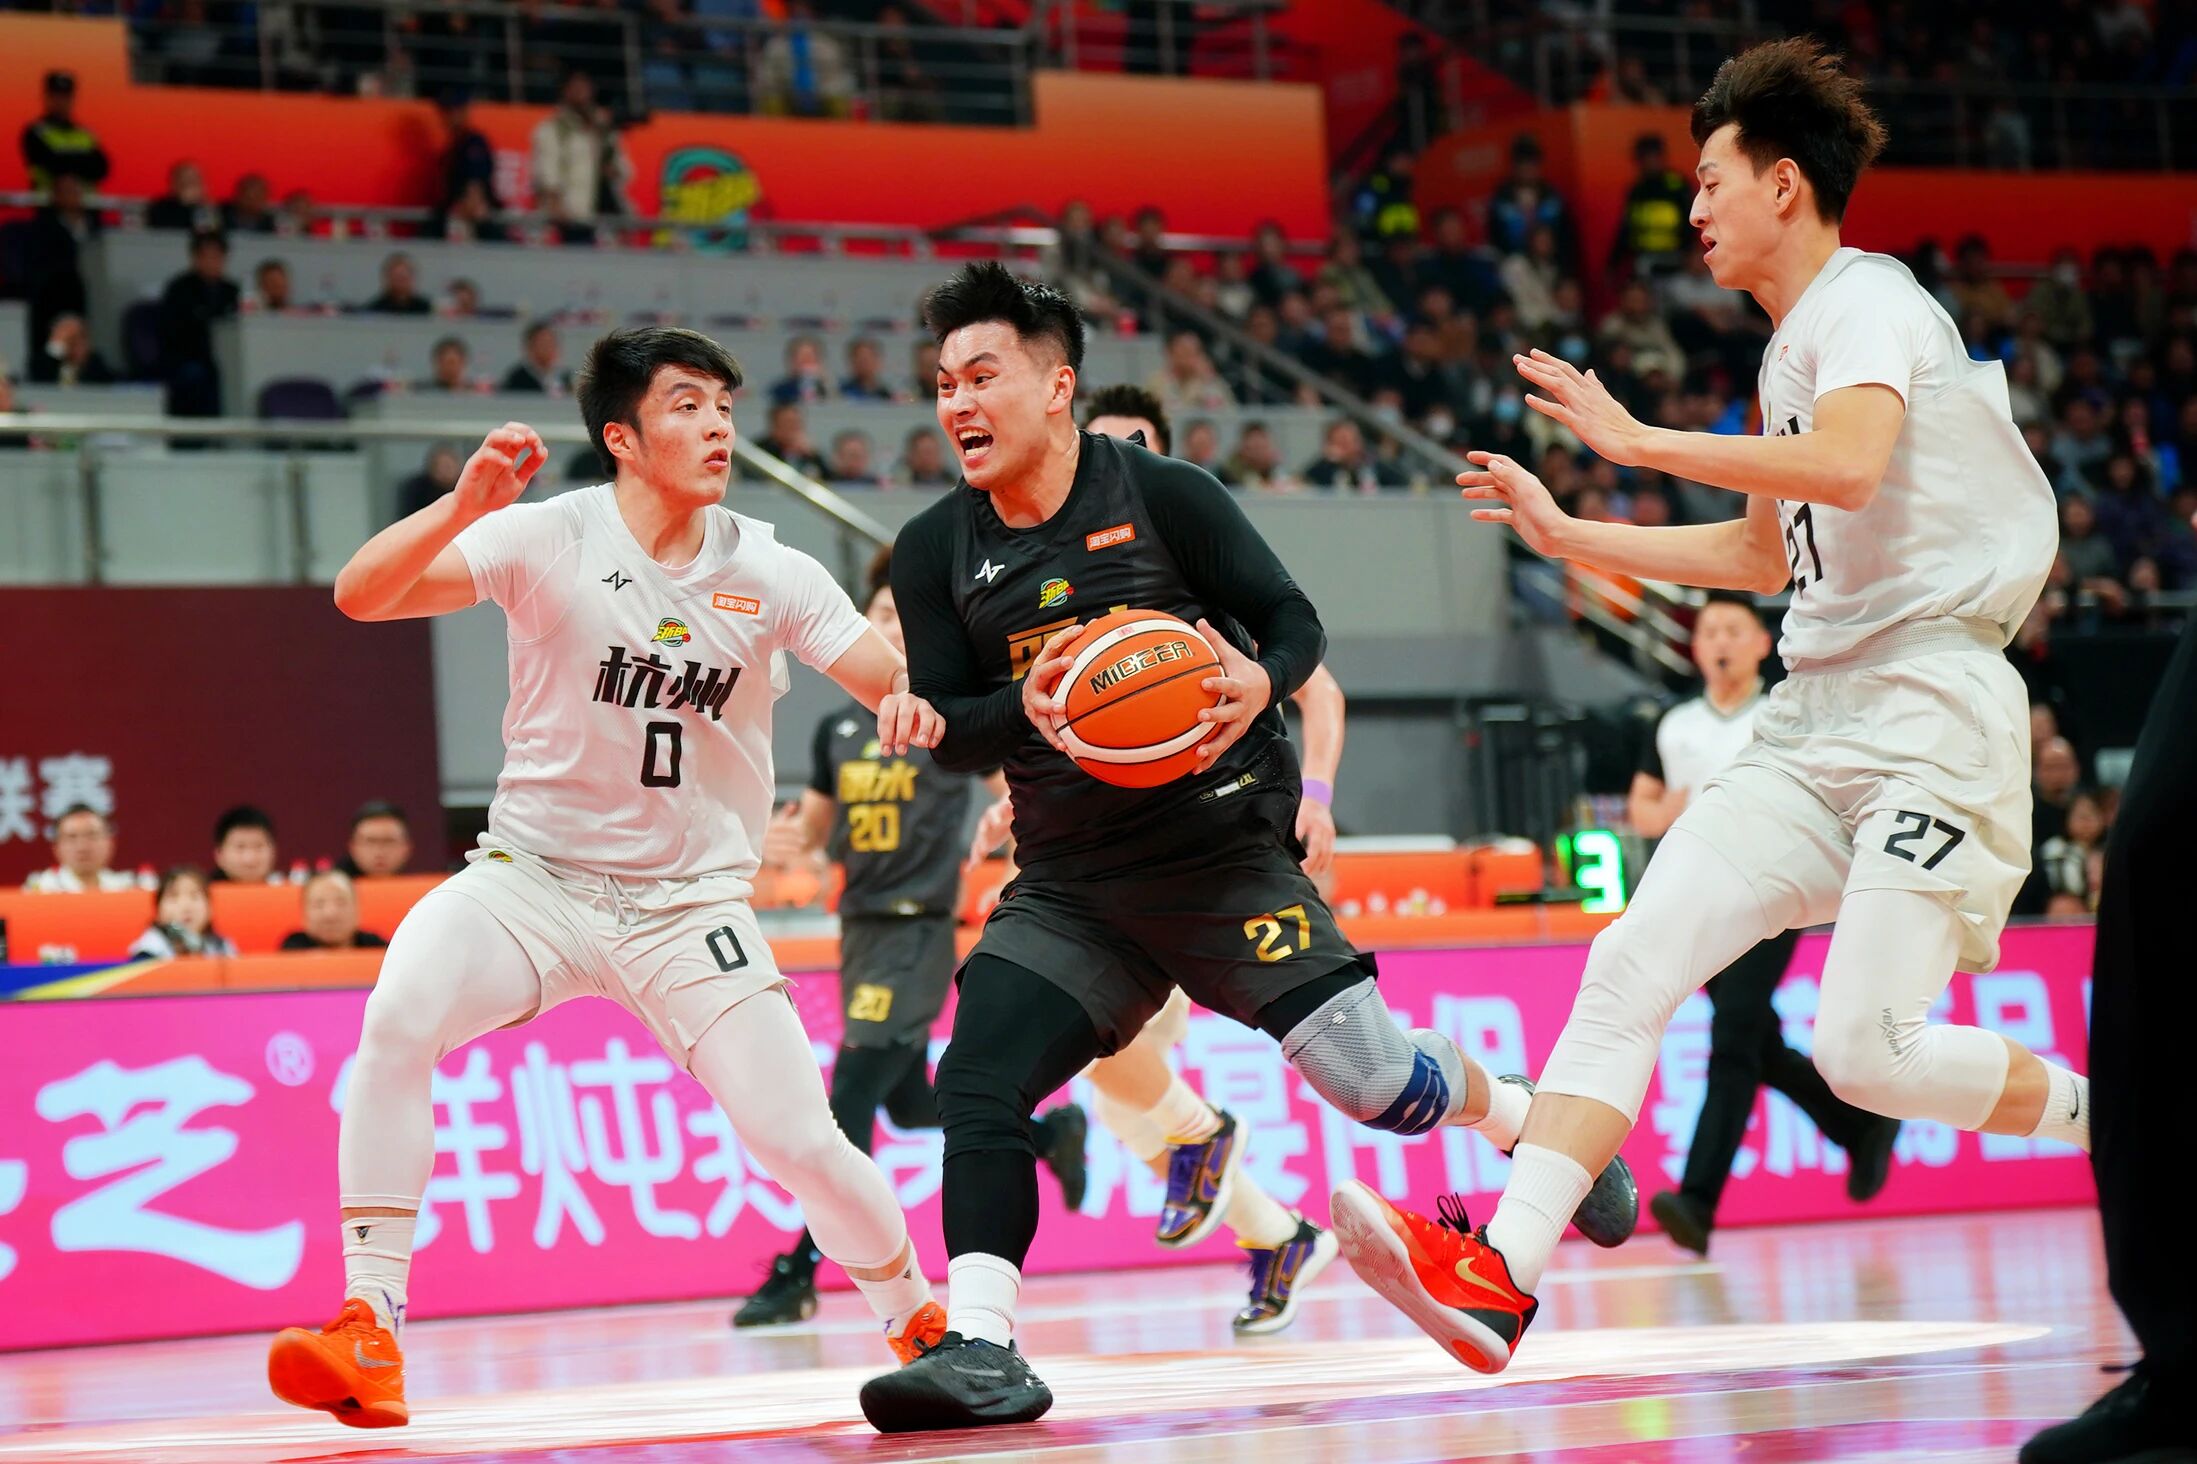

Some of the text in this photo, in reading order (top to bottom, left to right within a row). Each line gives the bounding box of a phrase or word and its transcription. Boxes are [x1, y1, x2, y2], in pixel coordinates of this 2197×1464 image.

[592, 645, 742, 722] 杭州
[640, 721, 683, 788] 0
[848, 803, 901, 852] 20
[1882, 810, 1967, 872] 27
[1573, 830, 1626, 914] 3
[705, 925, 749, 973] 0
[1243, 904, 1311, 962] 27
[848, 982, 894, 1023] 20
